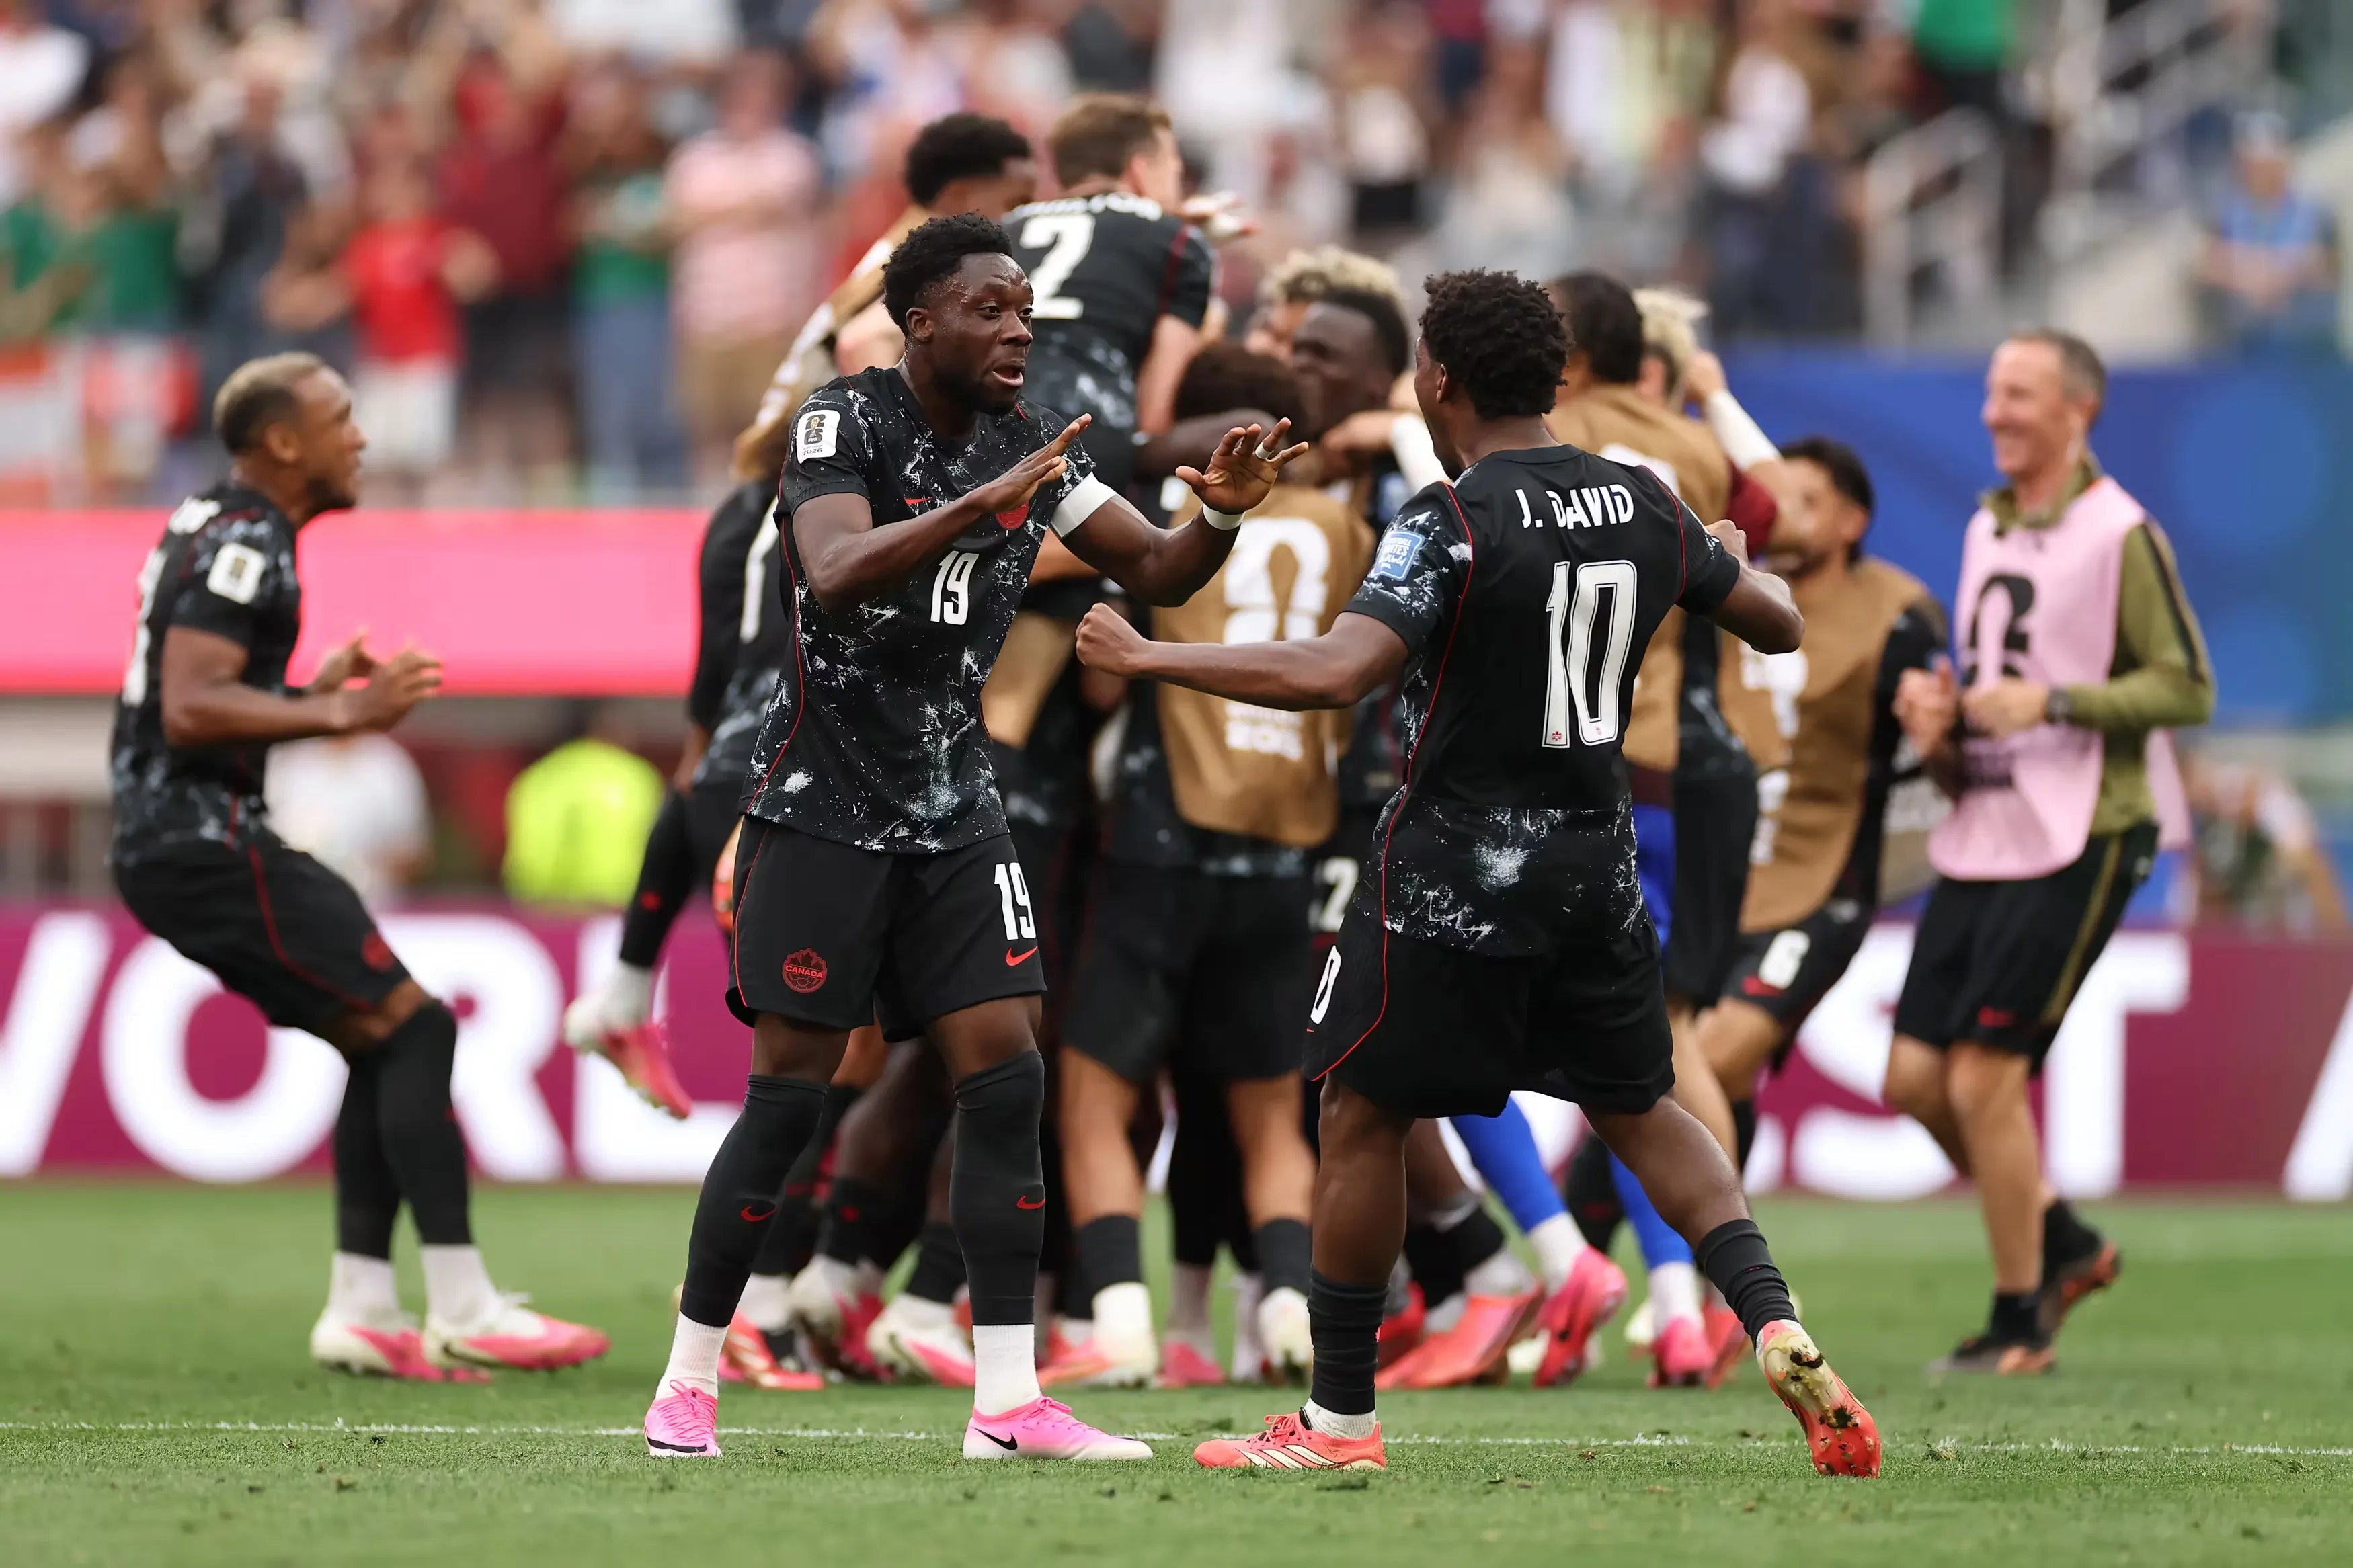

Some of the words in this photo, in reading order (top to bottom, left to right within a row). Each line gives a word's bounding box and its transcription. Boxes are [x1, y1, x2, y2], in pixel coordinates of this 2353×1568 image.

[1515, 489, 1543, 528] J.
[1546, 484, 1634, 530] DAVID
[930, 550, 979, 626] 19
[1542, 559, 1638, 749] 10
[994, 862, 1036, 940] 19
[785, 965, 823, 978] CANADA
